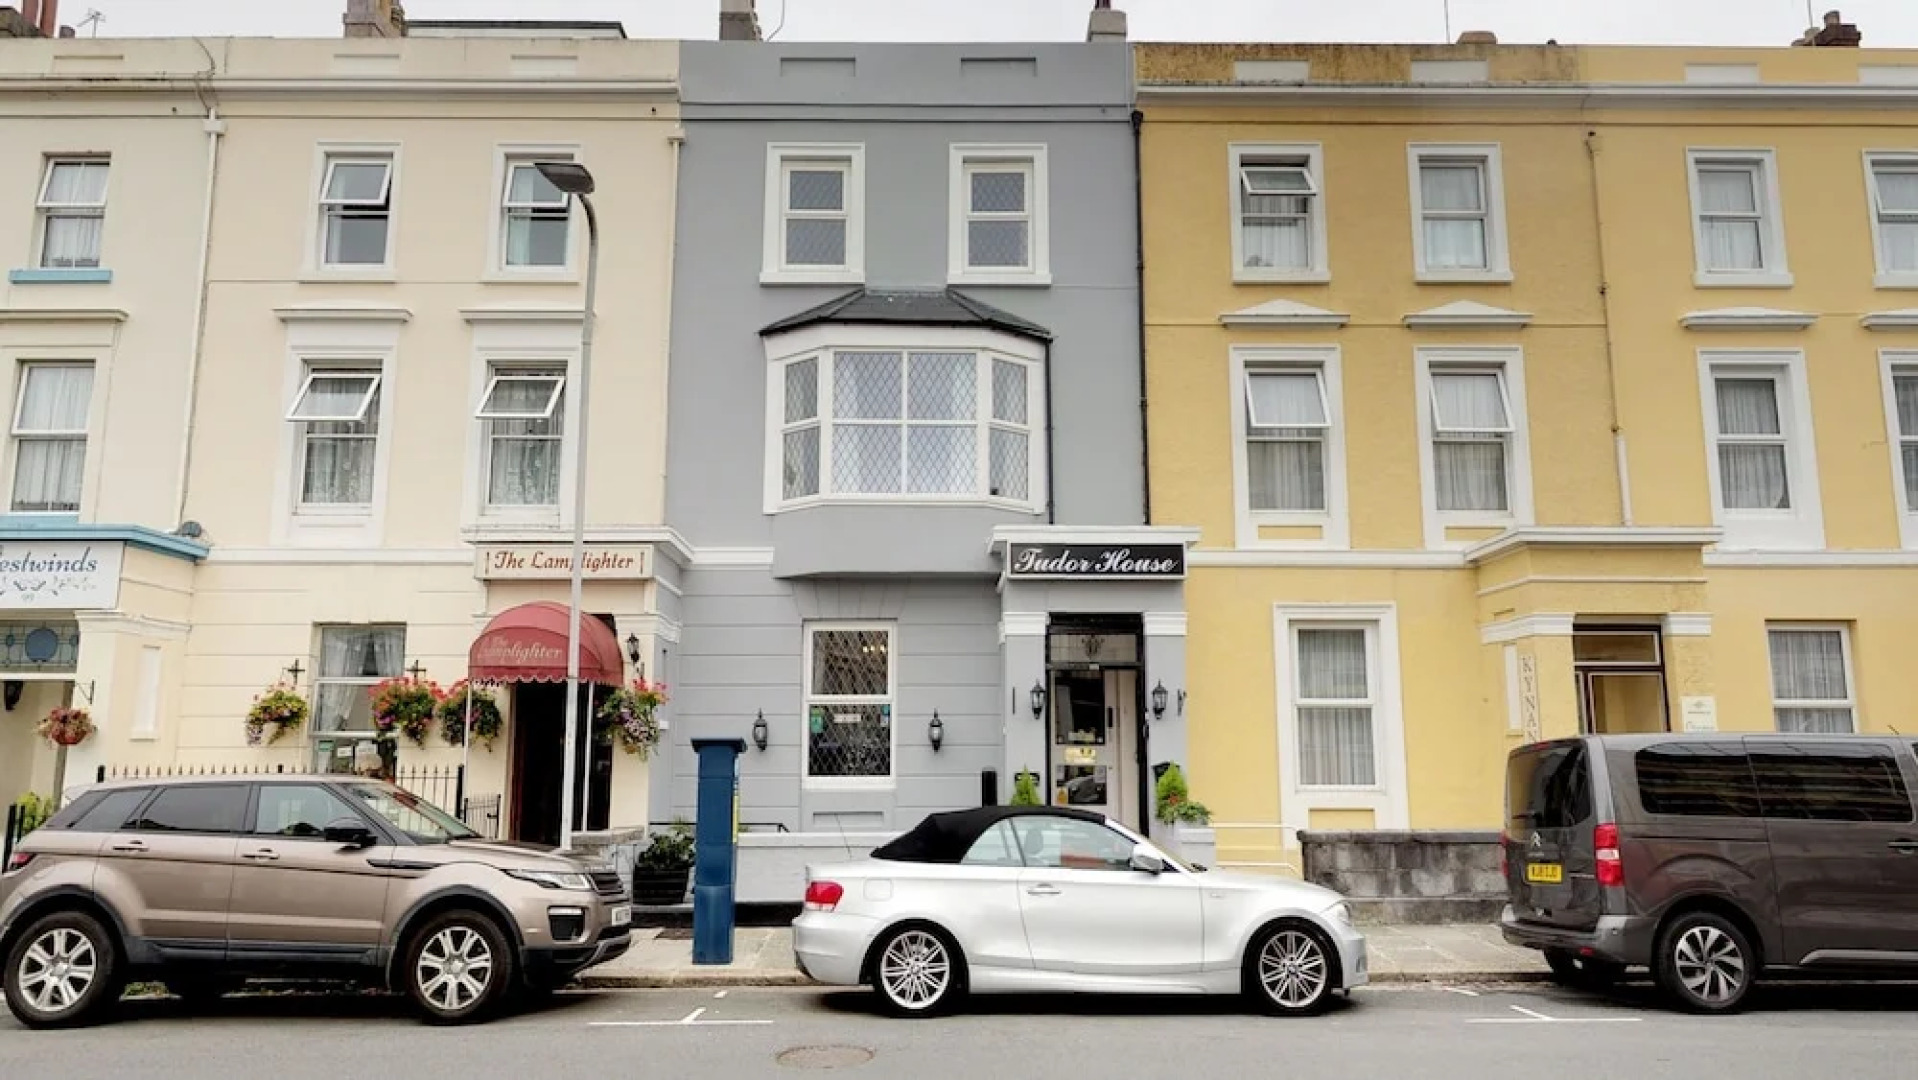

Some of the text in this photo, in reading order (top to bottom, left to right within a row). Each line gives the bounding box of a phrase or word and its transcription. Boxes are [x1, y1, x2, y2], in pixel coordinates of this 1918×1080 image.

[0, 545, 98, 573] estwinds
[494, 550, 634, 572] The Lamlighter
[1014, 548, 1178, 573] Tudor House
